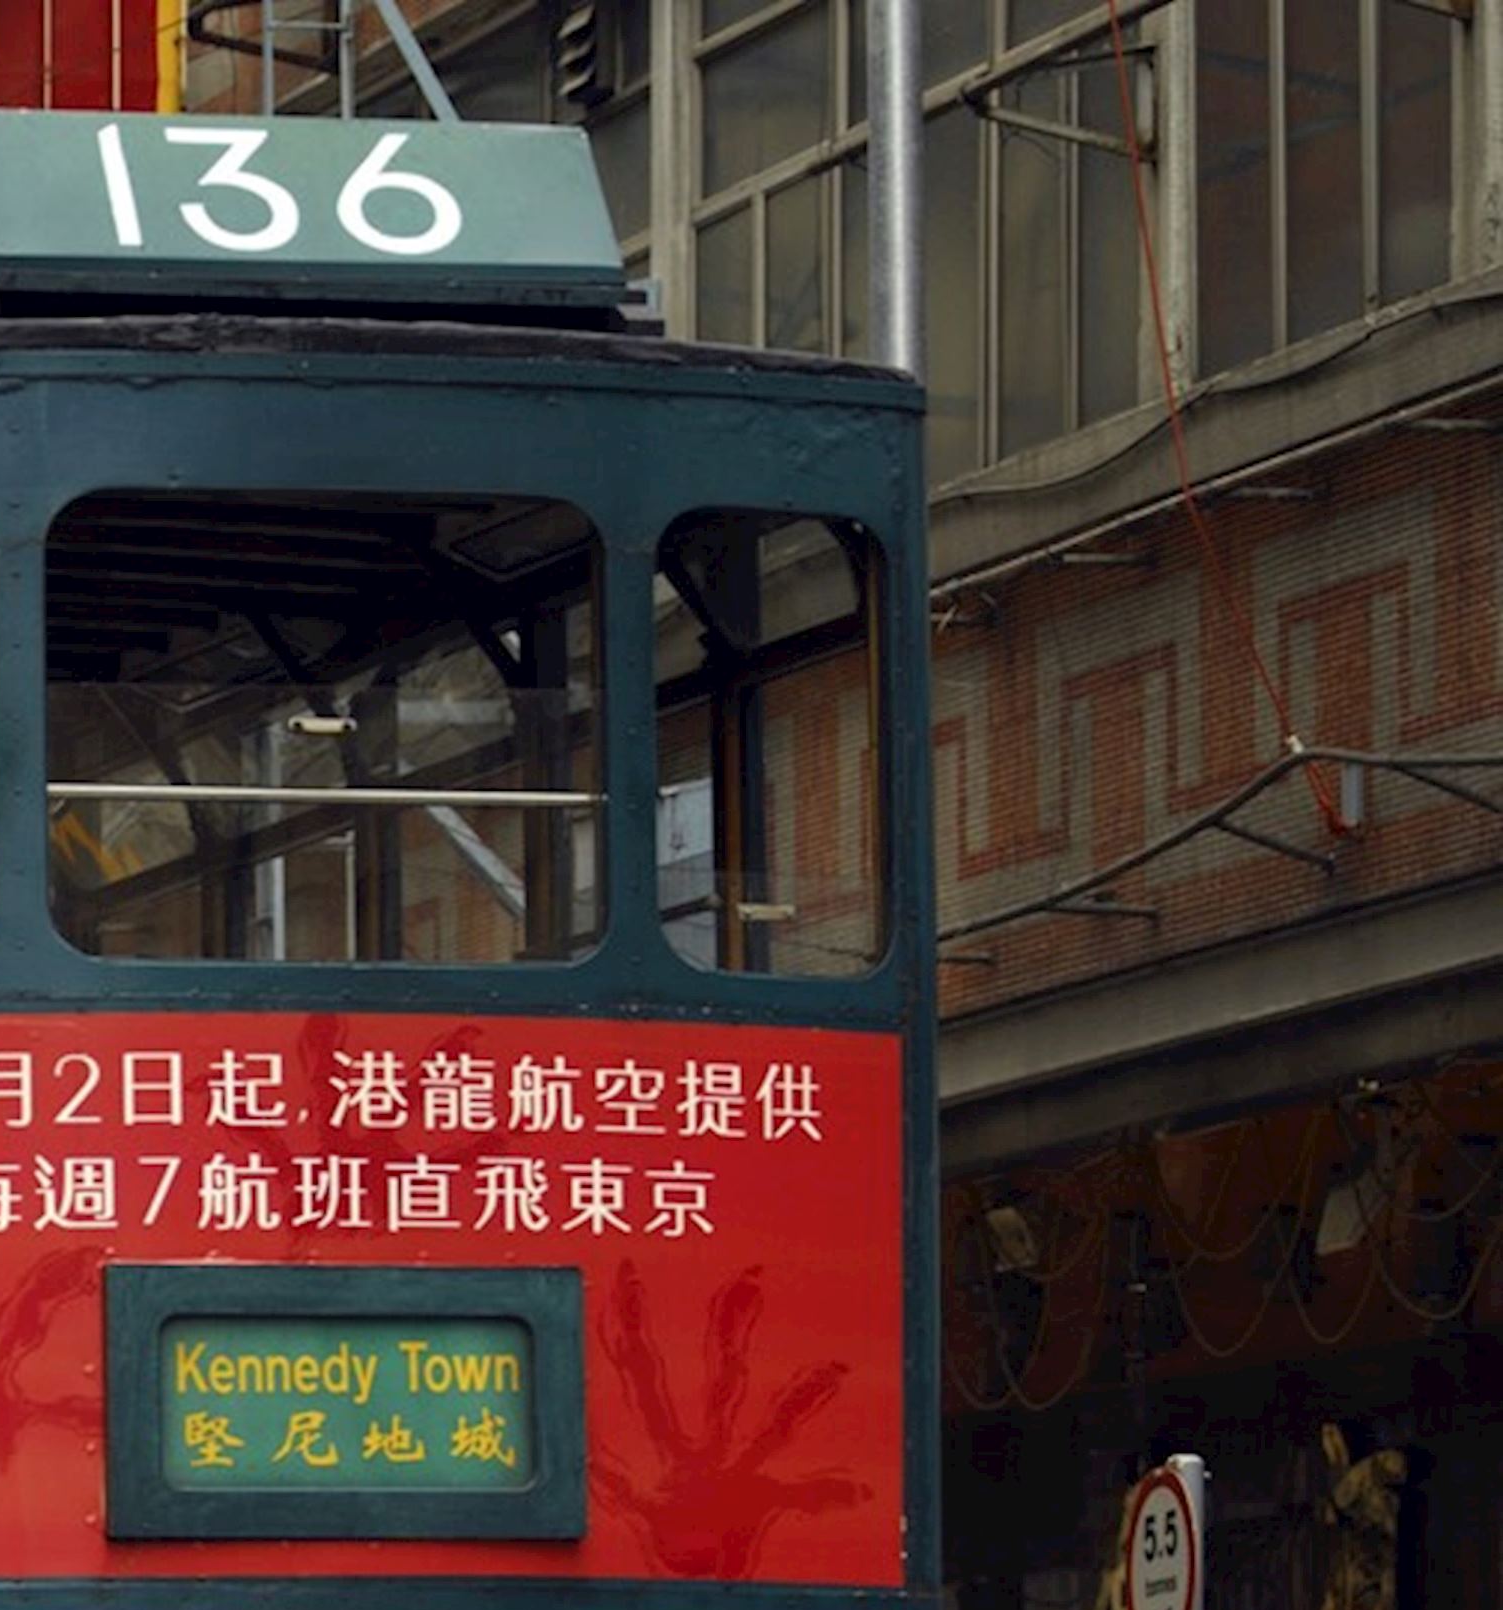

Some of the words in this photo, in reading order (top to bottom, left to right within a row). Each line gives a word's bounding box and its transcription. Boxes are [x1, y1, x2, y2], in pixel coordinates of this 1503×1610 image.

[97, 122, 463, 255] 136
[173, 1340, 378, 1405] Kennedy
[398, 1339, 522, 1394] Town
[182, 1406, 517, 1469] 堅尼地城
[1143, 1508, 1178, 1563] 5.5
